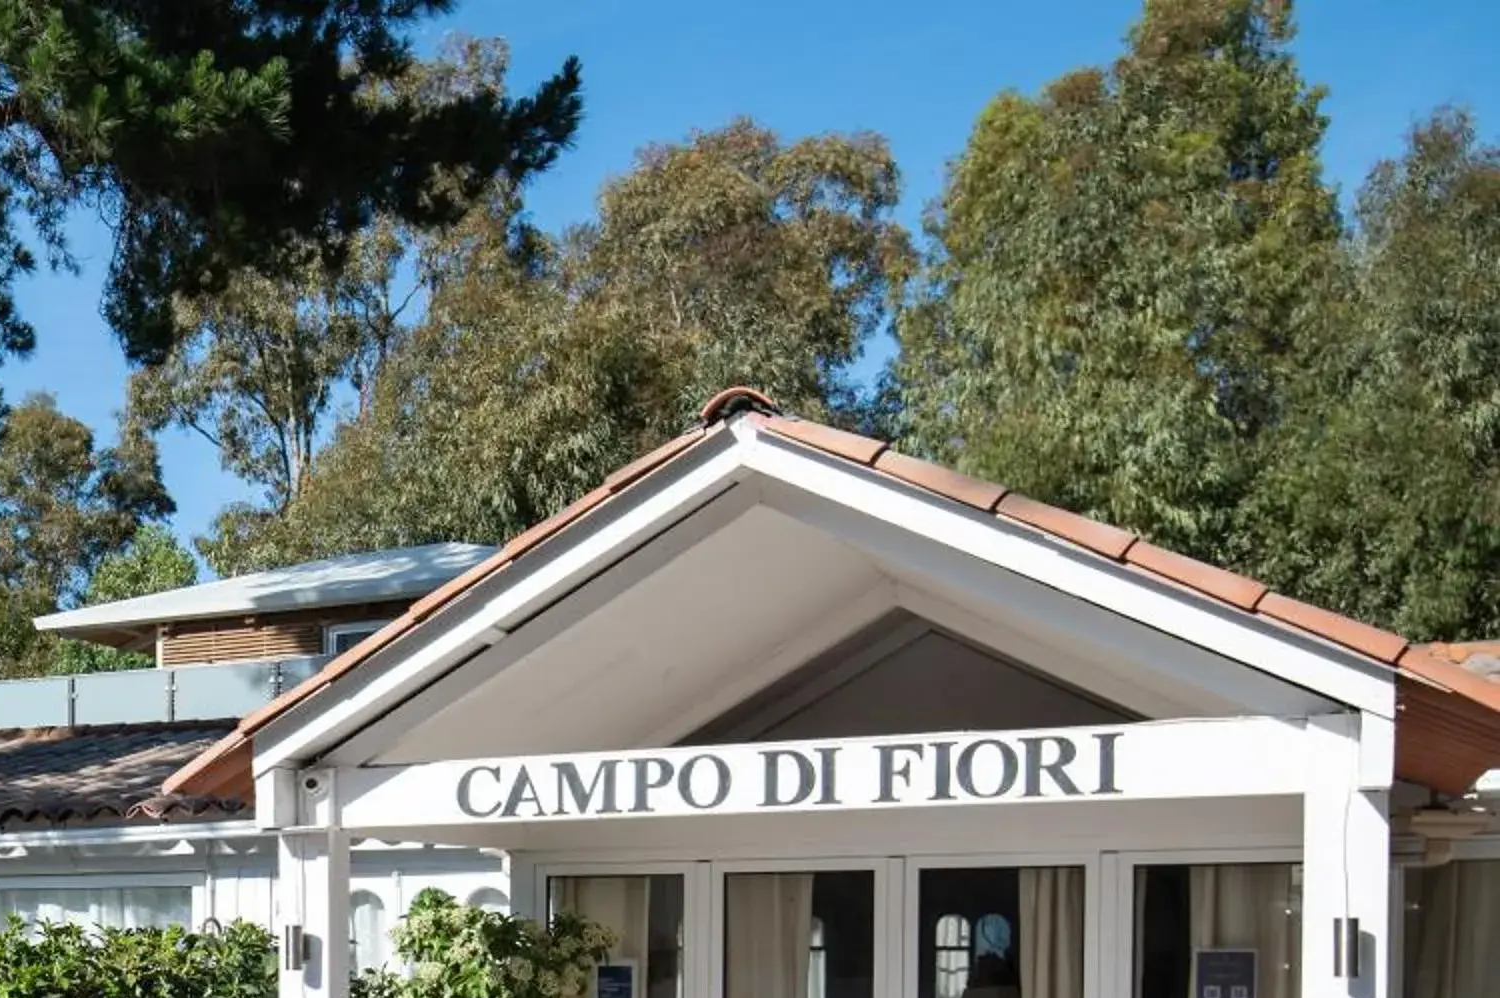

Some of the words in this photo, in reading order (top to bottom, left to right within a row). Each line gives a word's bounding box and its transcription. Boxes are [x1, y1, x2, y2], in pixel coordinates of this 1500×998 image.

[456, 754, 732, 818] CAMPO
[757, 747, 843, 807] DI
[871, 732, 1126, 803] FIORI
